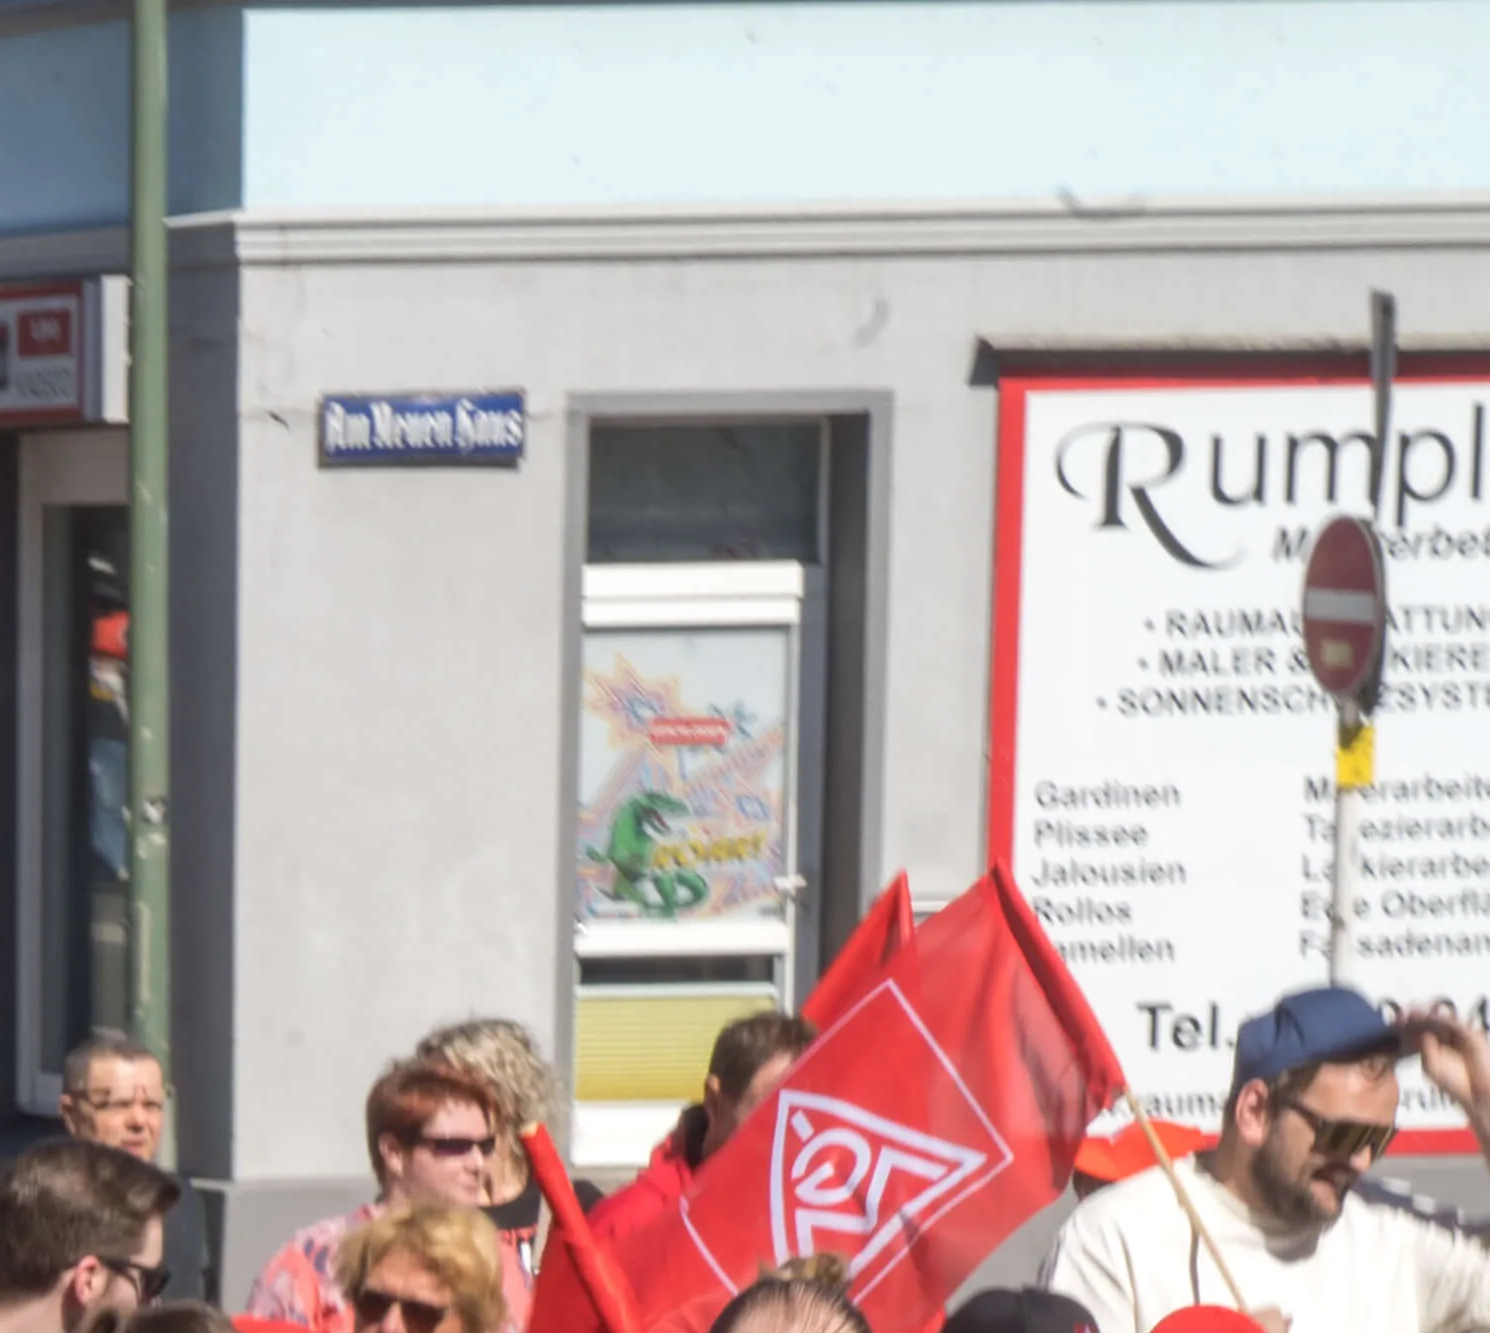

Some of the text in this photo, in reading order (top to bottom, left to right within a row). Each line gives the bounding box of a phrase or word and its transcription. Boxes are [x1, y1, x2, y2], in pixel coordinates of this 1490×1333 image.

[1158, 646, 1277, 678] MALER
[1033, 778, 1183, 811] Gardinen
[1033, 820, 1149, 848] Plissee
[1032, 857, 1187, 888] Jalousien
[1034, 896, 1134, 926] Rollos
[1052, 935, 1176, 963] amellen
[1136, 1002, 1236, 1050] Tel.
